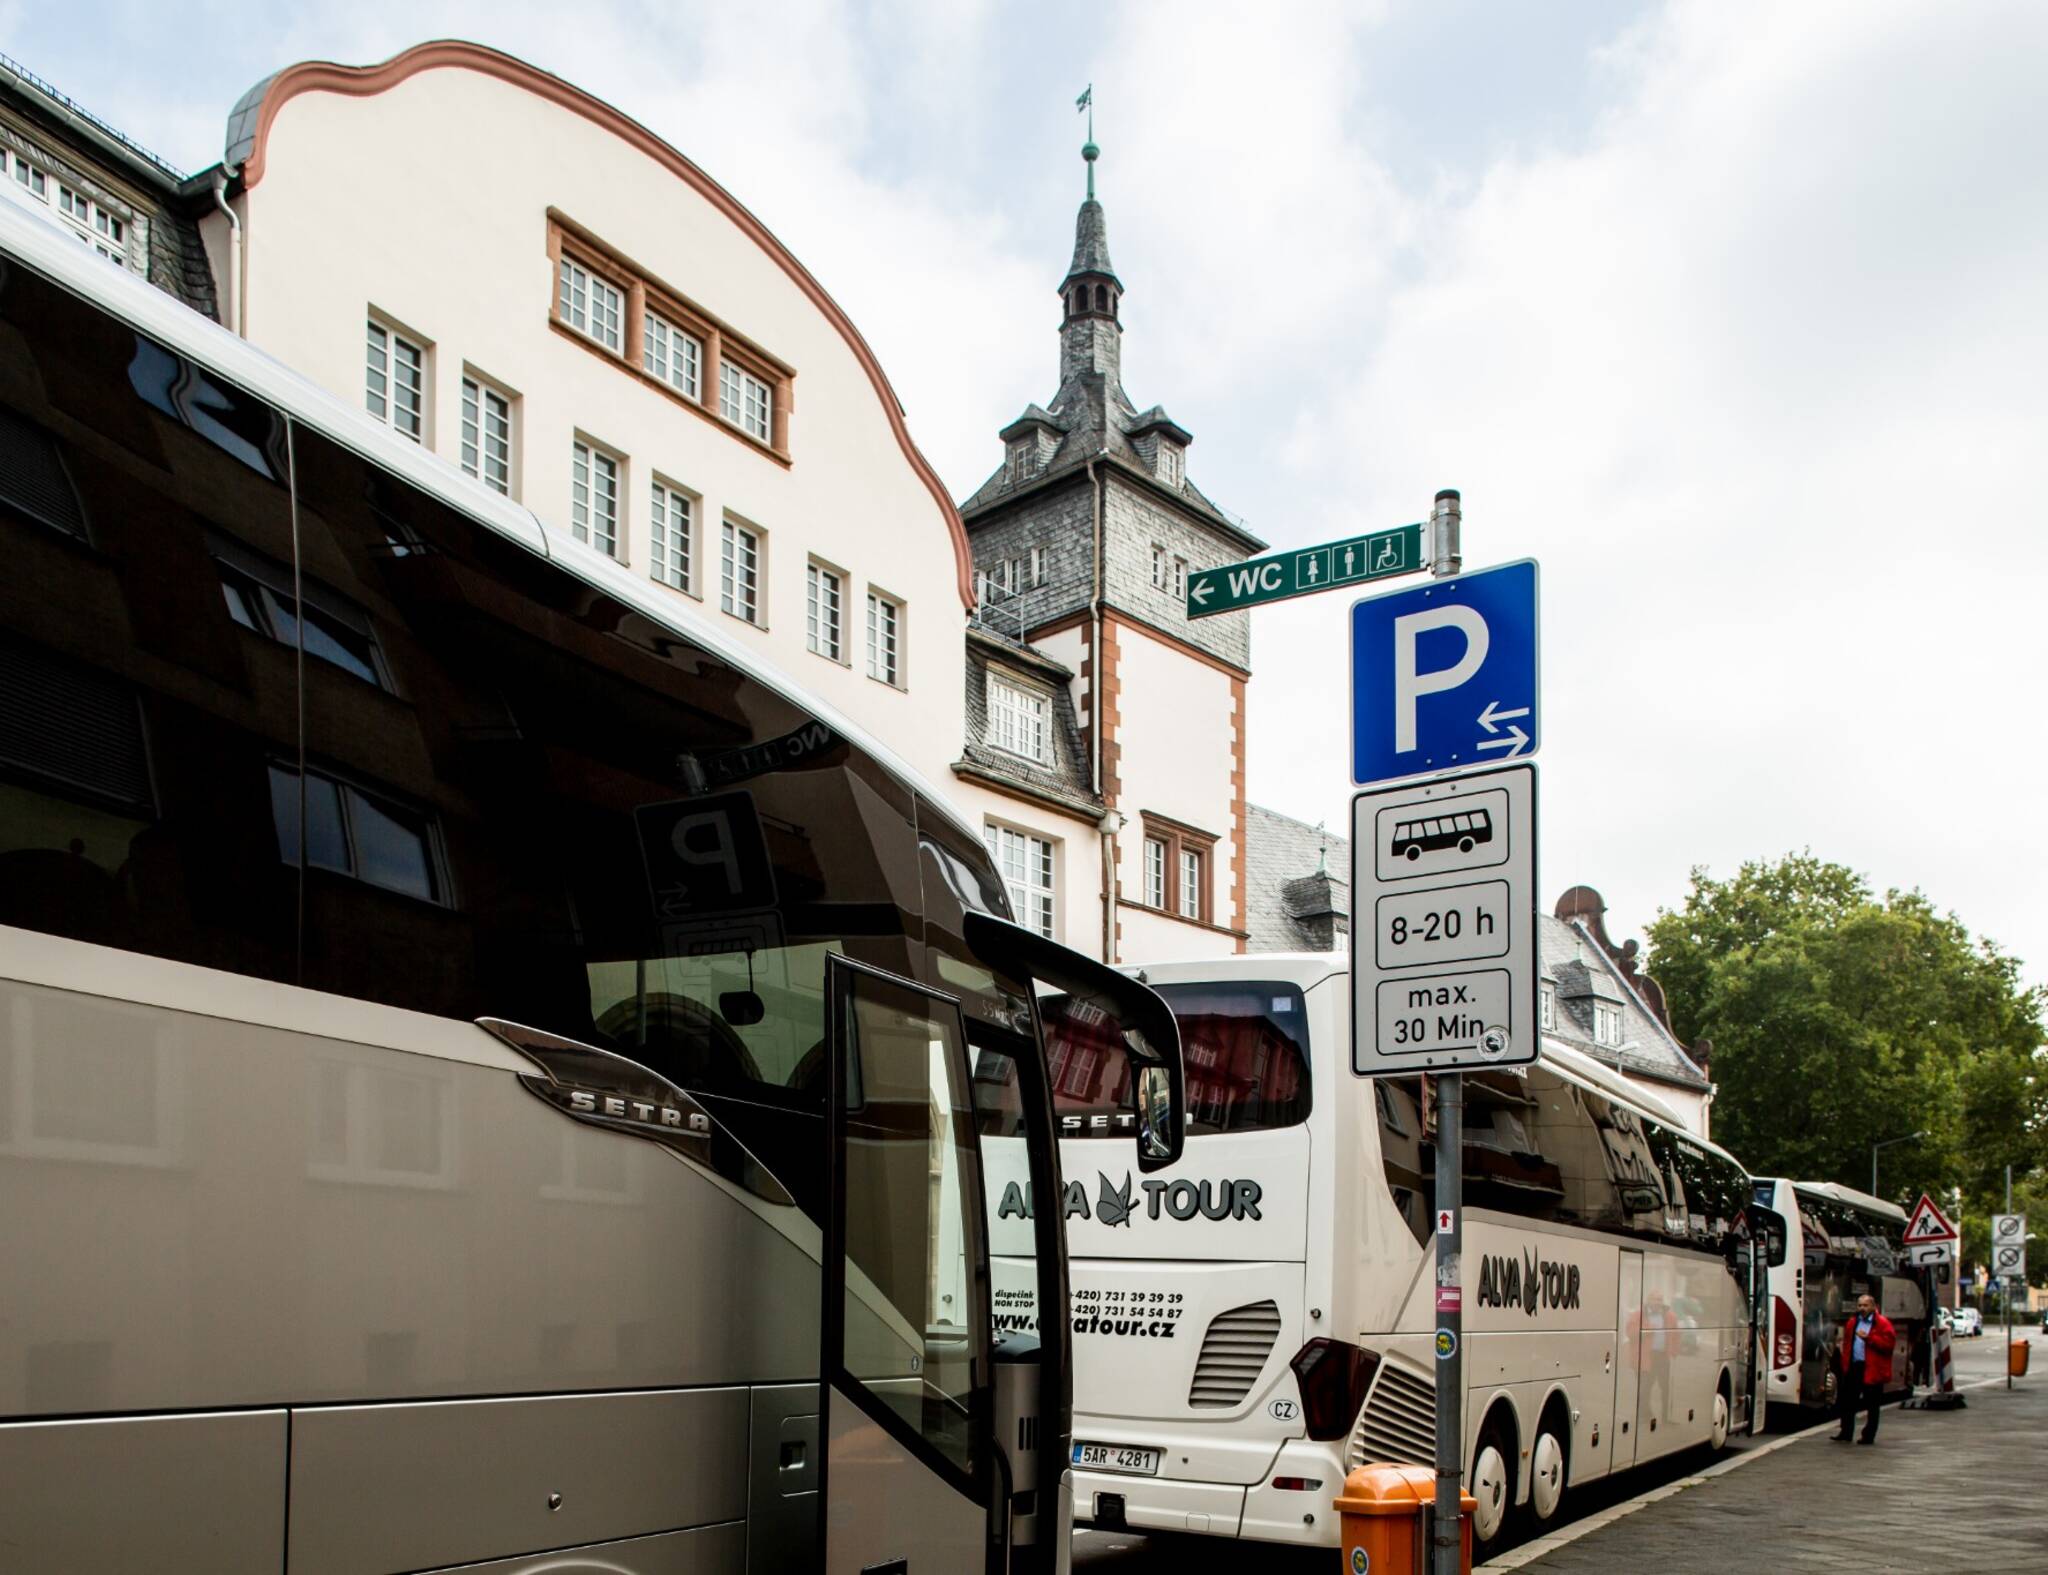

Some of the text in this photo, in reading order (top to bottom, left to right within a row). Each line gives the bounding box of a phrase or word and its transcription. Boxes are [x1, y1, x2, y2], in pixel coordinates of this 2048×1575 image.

[1228, 563, 1283, 599] WC
[1394, 604, 1490, 754] P
[1391, 906, 1494, 945] 8-20 h
[1408, 985, 1477, 1008] max.
[1394, 1018, 1425, 1043] 30
[571, 1091, 710, 1131] SETRA
[1140, 1179, 1262, 1221] TOUR
[1477, 1254, 1580, 1310] ALVA TOUR
[1015, 1300, 1034, 1308] STOP
[1105, 1291, 1125, 1301] 731
[1130, 1292, 1145, 1302] 39
[1148, 1293, 1164, 1302] 39
[1167, 1294, 1183, 1303] 39
[1105, 1306, 1124, 1316] 731
[1129, 1307, 1144, 1317] 54
[1148, 1308, 1163, 1317] 54
[1167, 1309, 1183, 1318] 87
[1275, 1402, 1292, 1418] CZ
[1084, 1447, 1150, 1468] 5AR 4281
